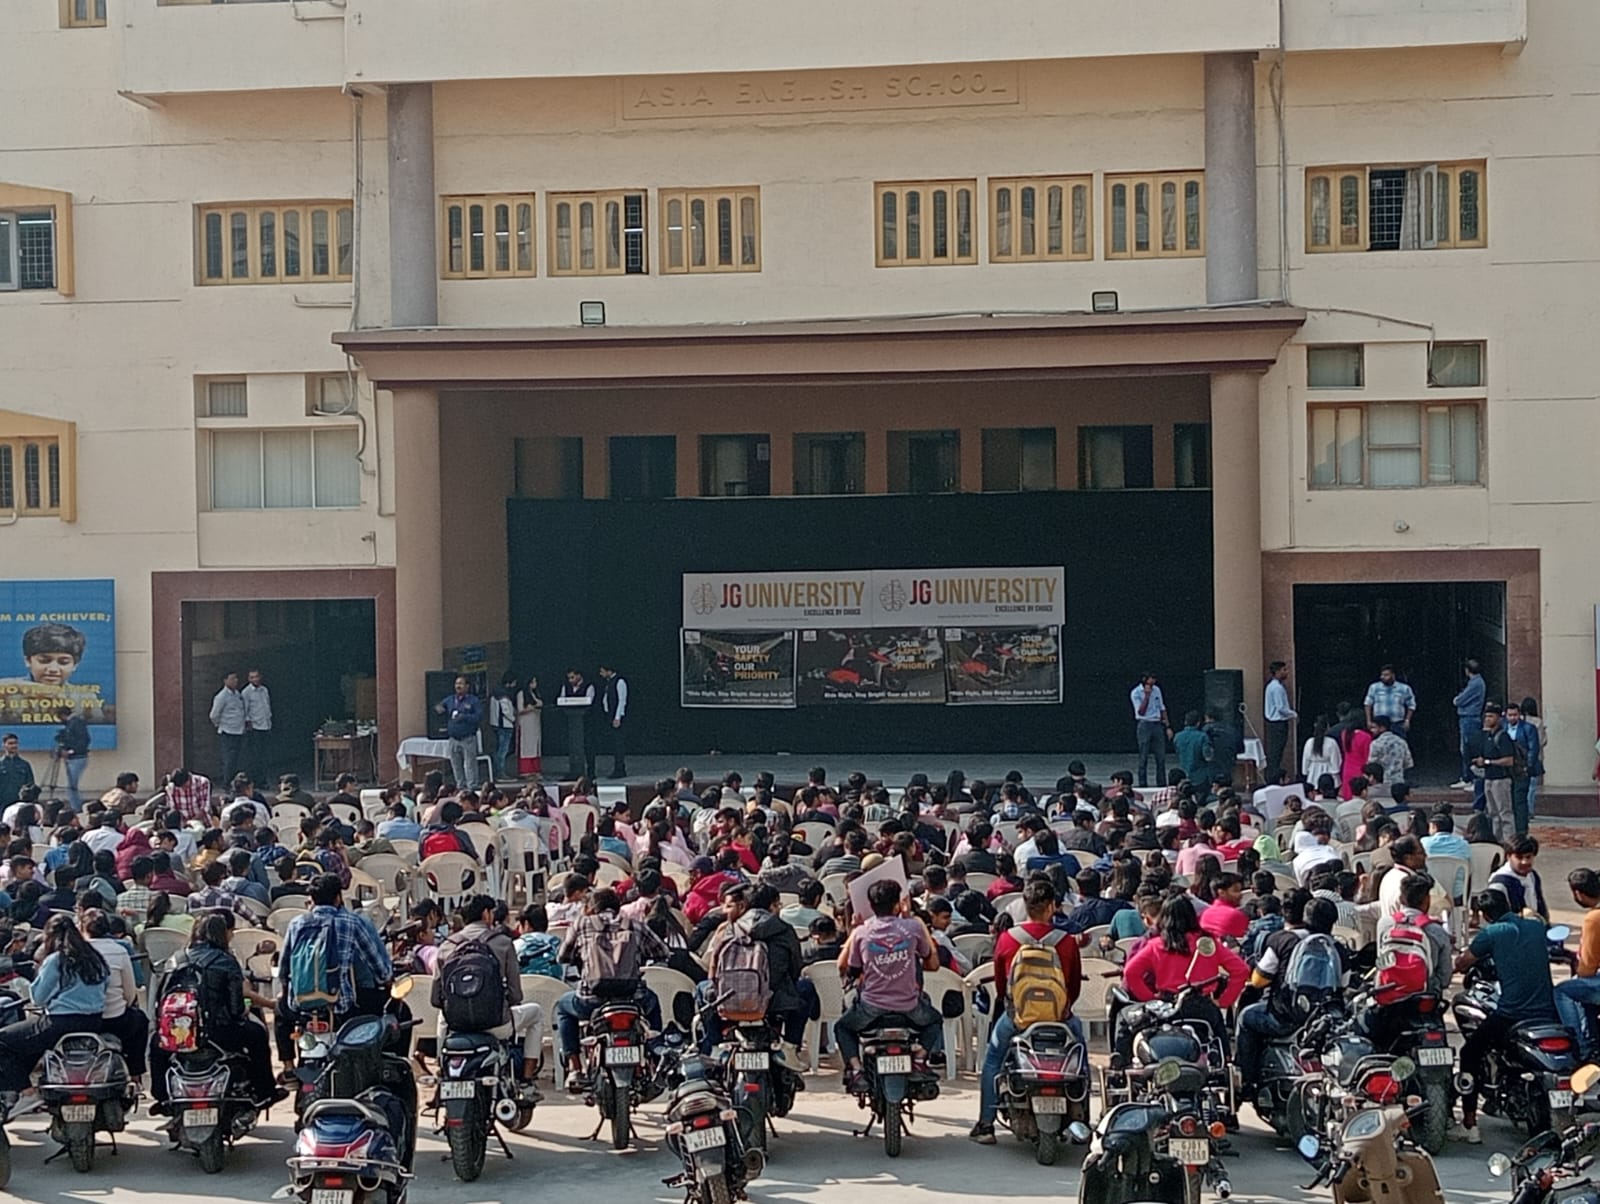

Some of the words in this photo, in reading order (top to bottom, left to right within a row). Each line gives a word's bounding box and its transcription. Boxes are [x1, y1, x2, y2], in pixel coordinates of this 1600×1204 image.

[720, 583, 742, 608] JG
[745, 581, 865, 608] UNIVERSITY
[909, 580, 932, 605] JG
[935, 577, 1057, 604] UNIVERSITY
[16, 613, 35, 622] AN
[40, 612, 111, 622] ACHIEVER;
[734, 645, 760, 654] YOUR
[735, 654, 770, 662] SAFETY
[734, 671, 779, 680] PRIORITY
[10, 699, 75, 709] BEYOND
[81, 699, 105, 708] MY
